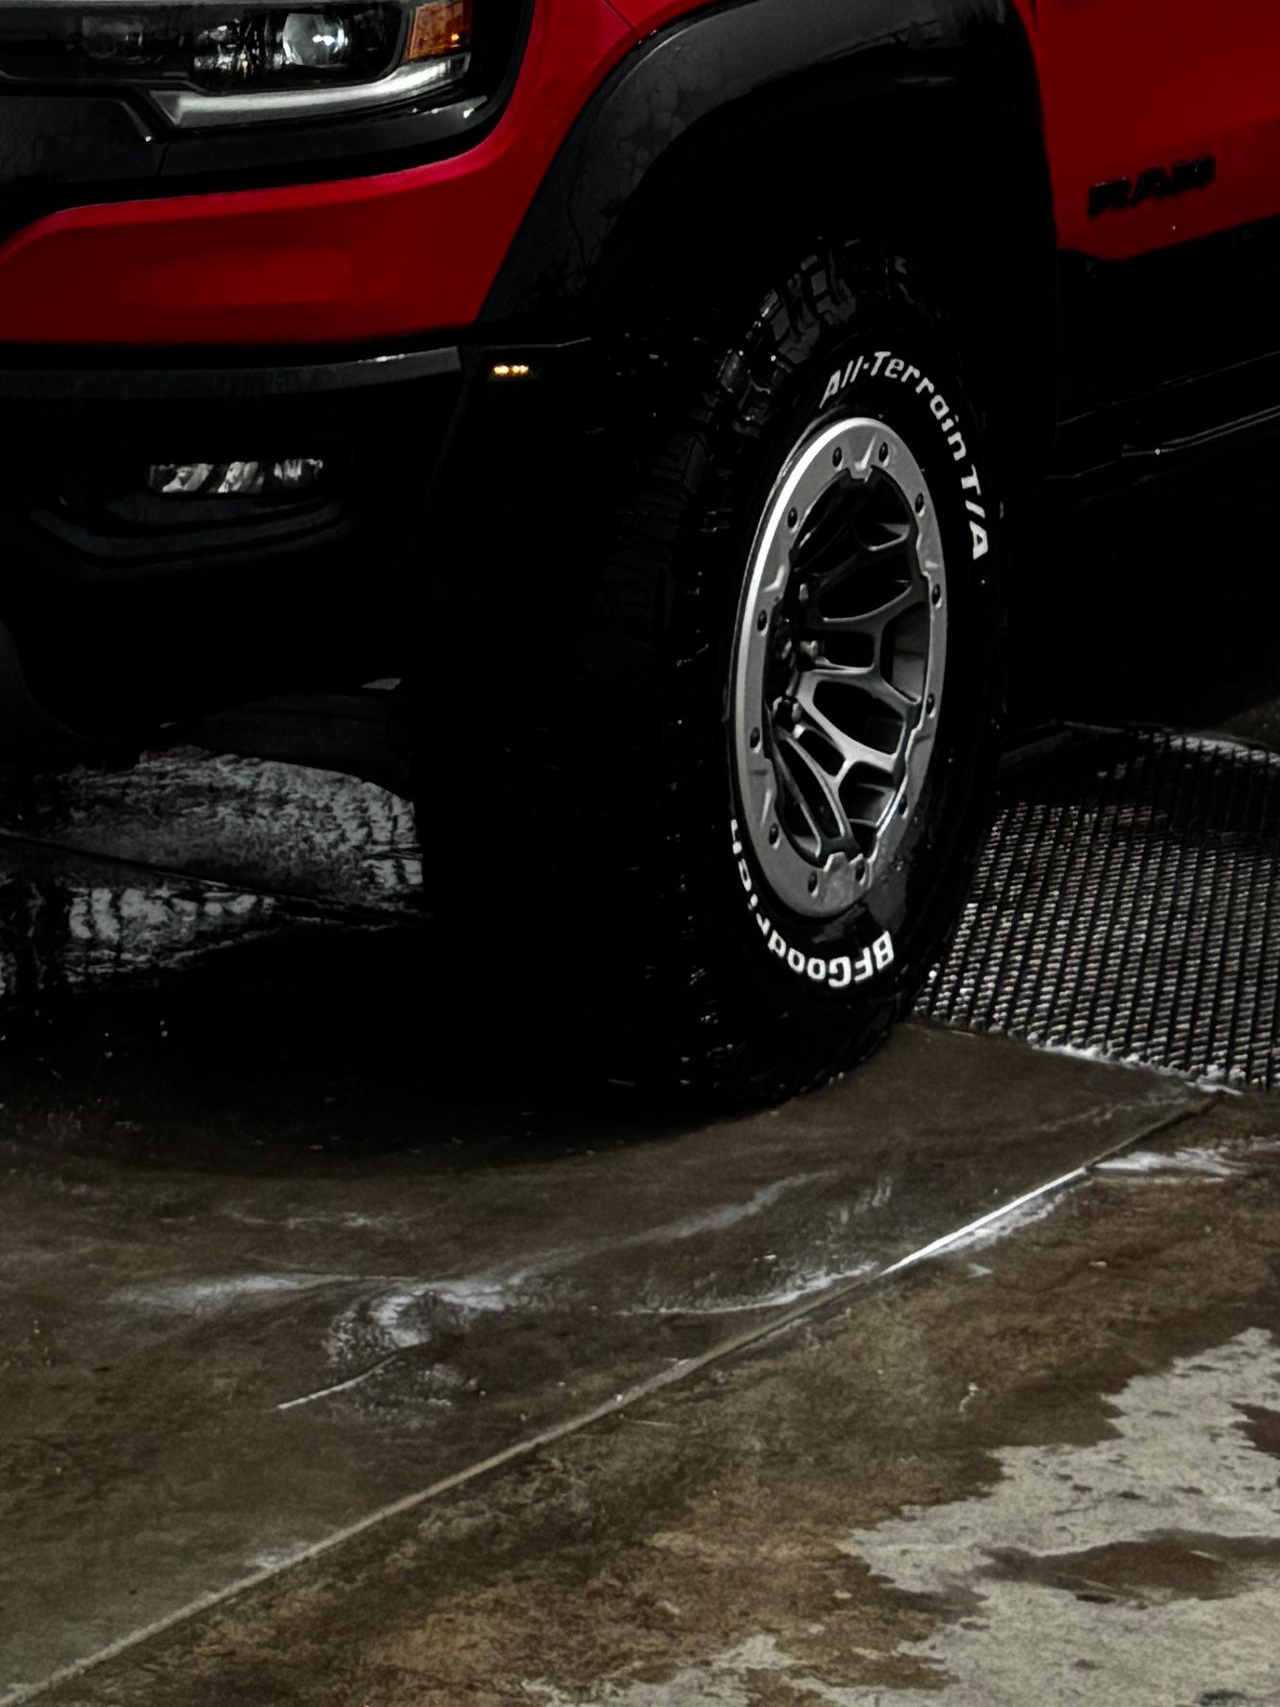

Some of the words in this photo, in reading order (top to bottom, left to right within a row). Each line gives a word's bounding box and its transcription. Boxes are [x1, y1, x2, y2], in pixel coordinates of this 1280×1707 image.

[819, 350, 967, 462] All-Terrain
[960, 462, 989, 561] T/A
[730, 818, 895, 988] BFGoodrich
